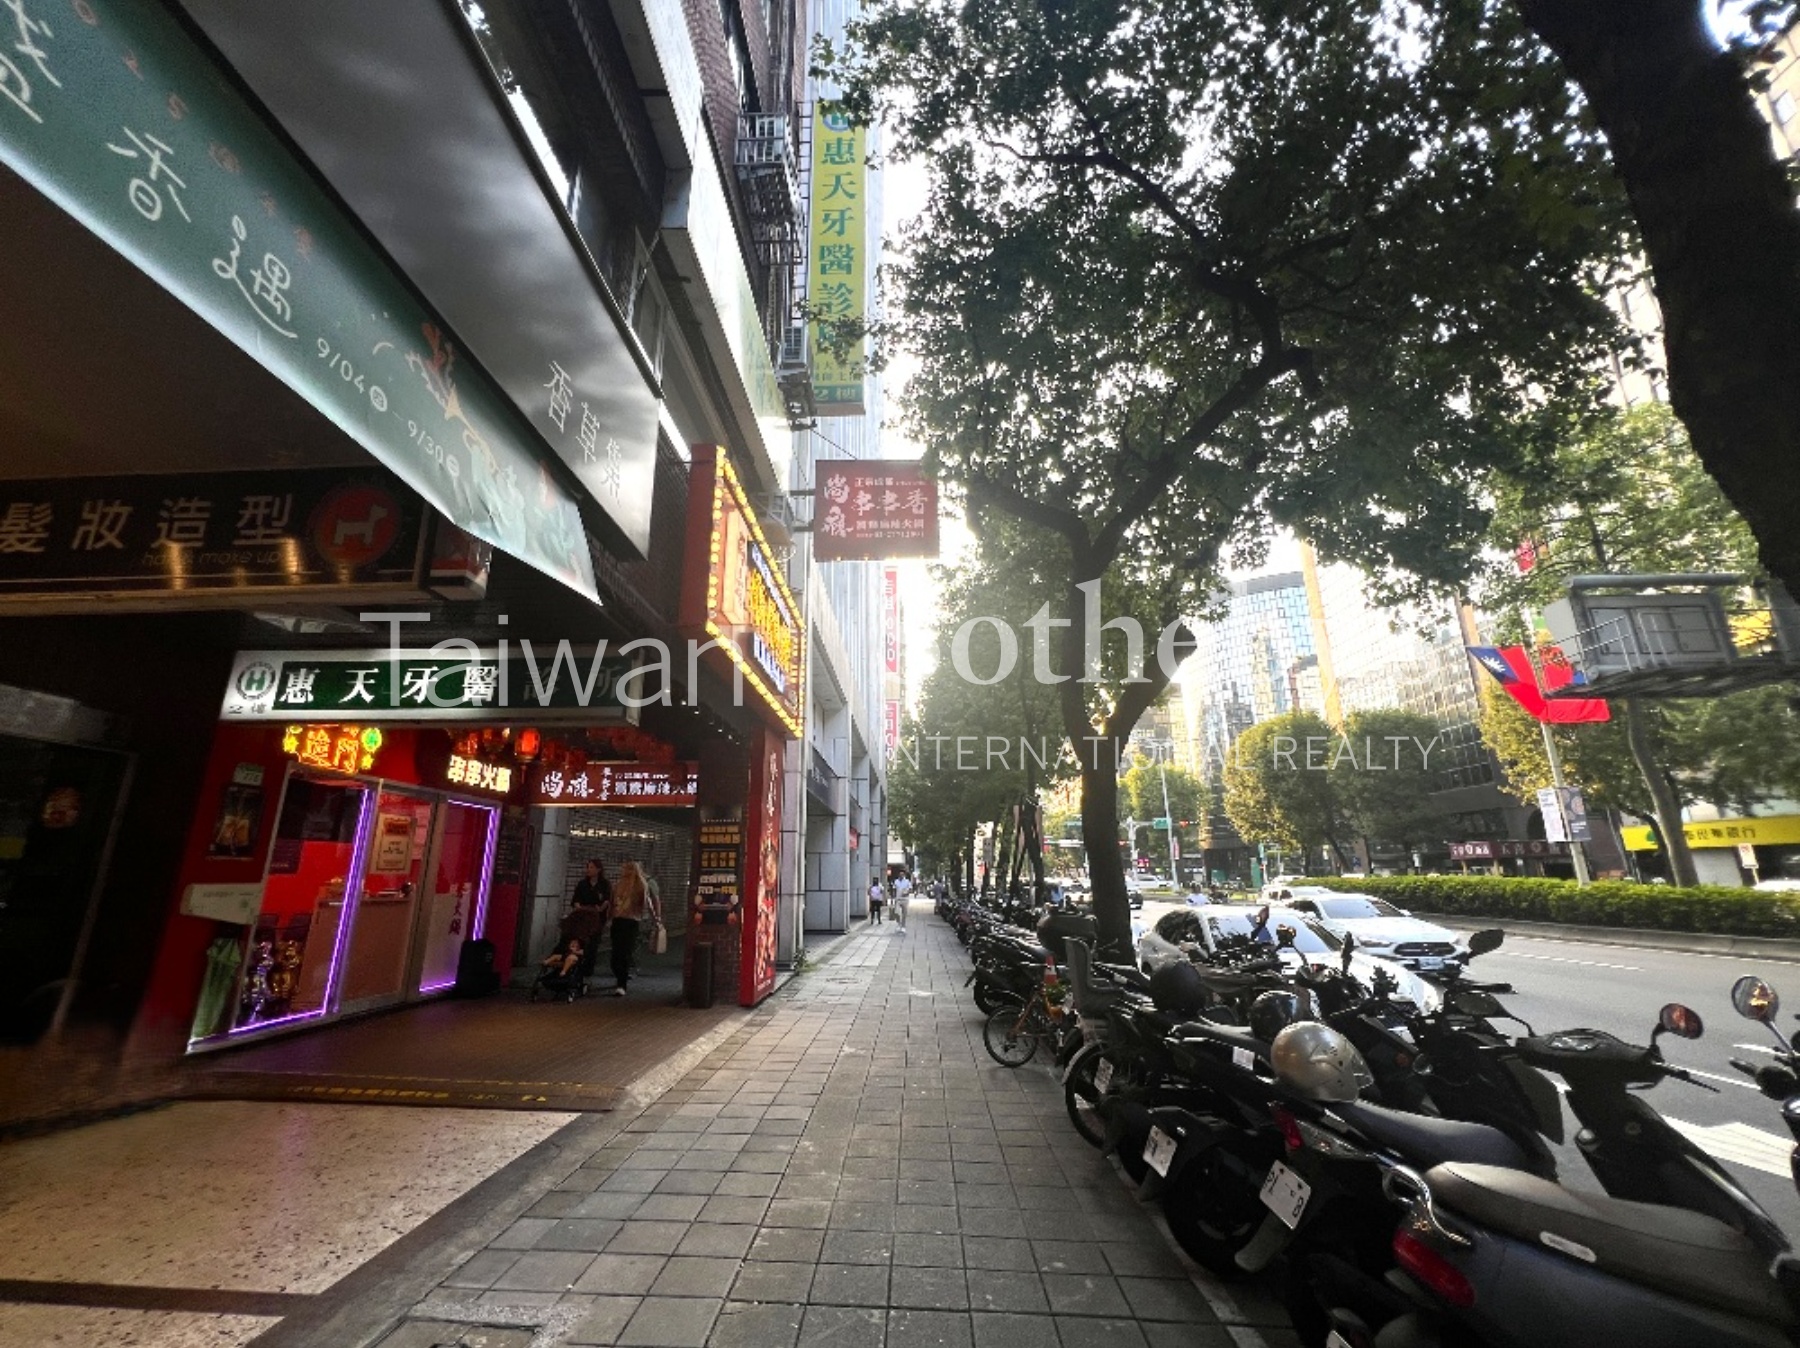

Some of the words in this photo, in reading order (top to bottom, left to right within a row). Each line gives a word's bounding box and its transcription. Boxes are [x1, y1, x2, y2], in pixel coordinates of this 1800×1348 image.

[817, 136, 856, 342] 惠天牙醫診
